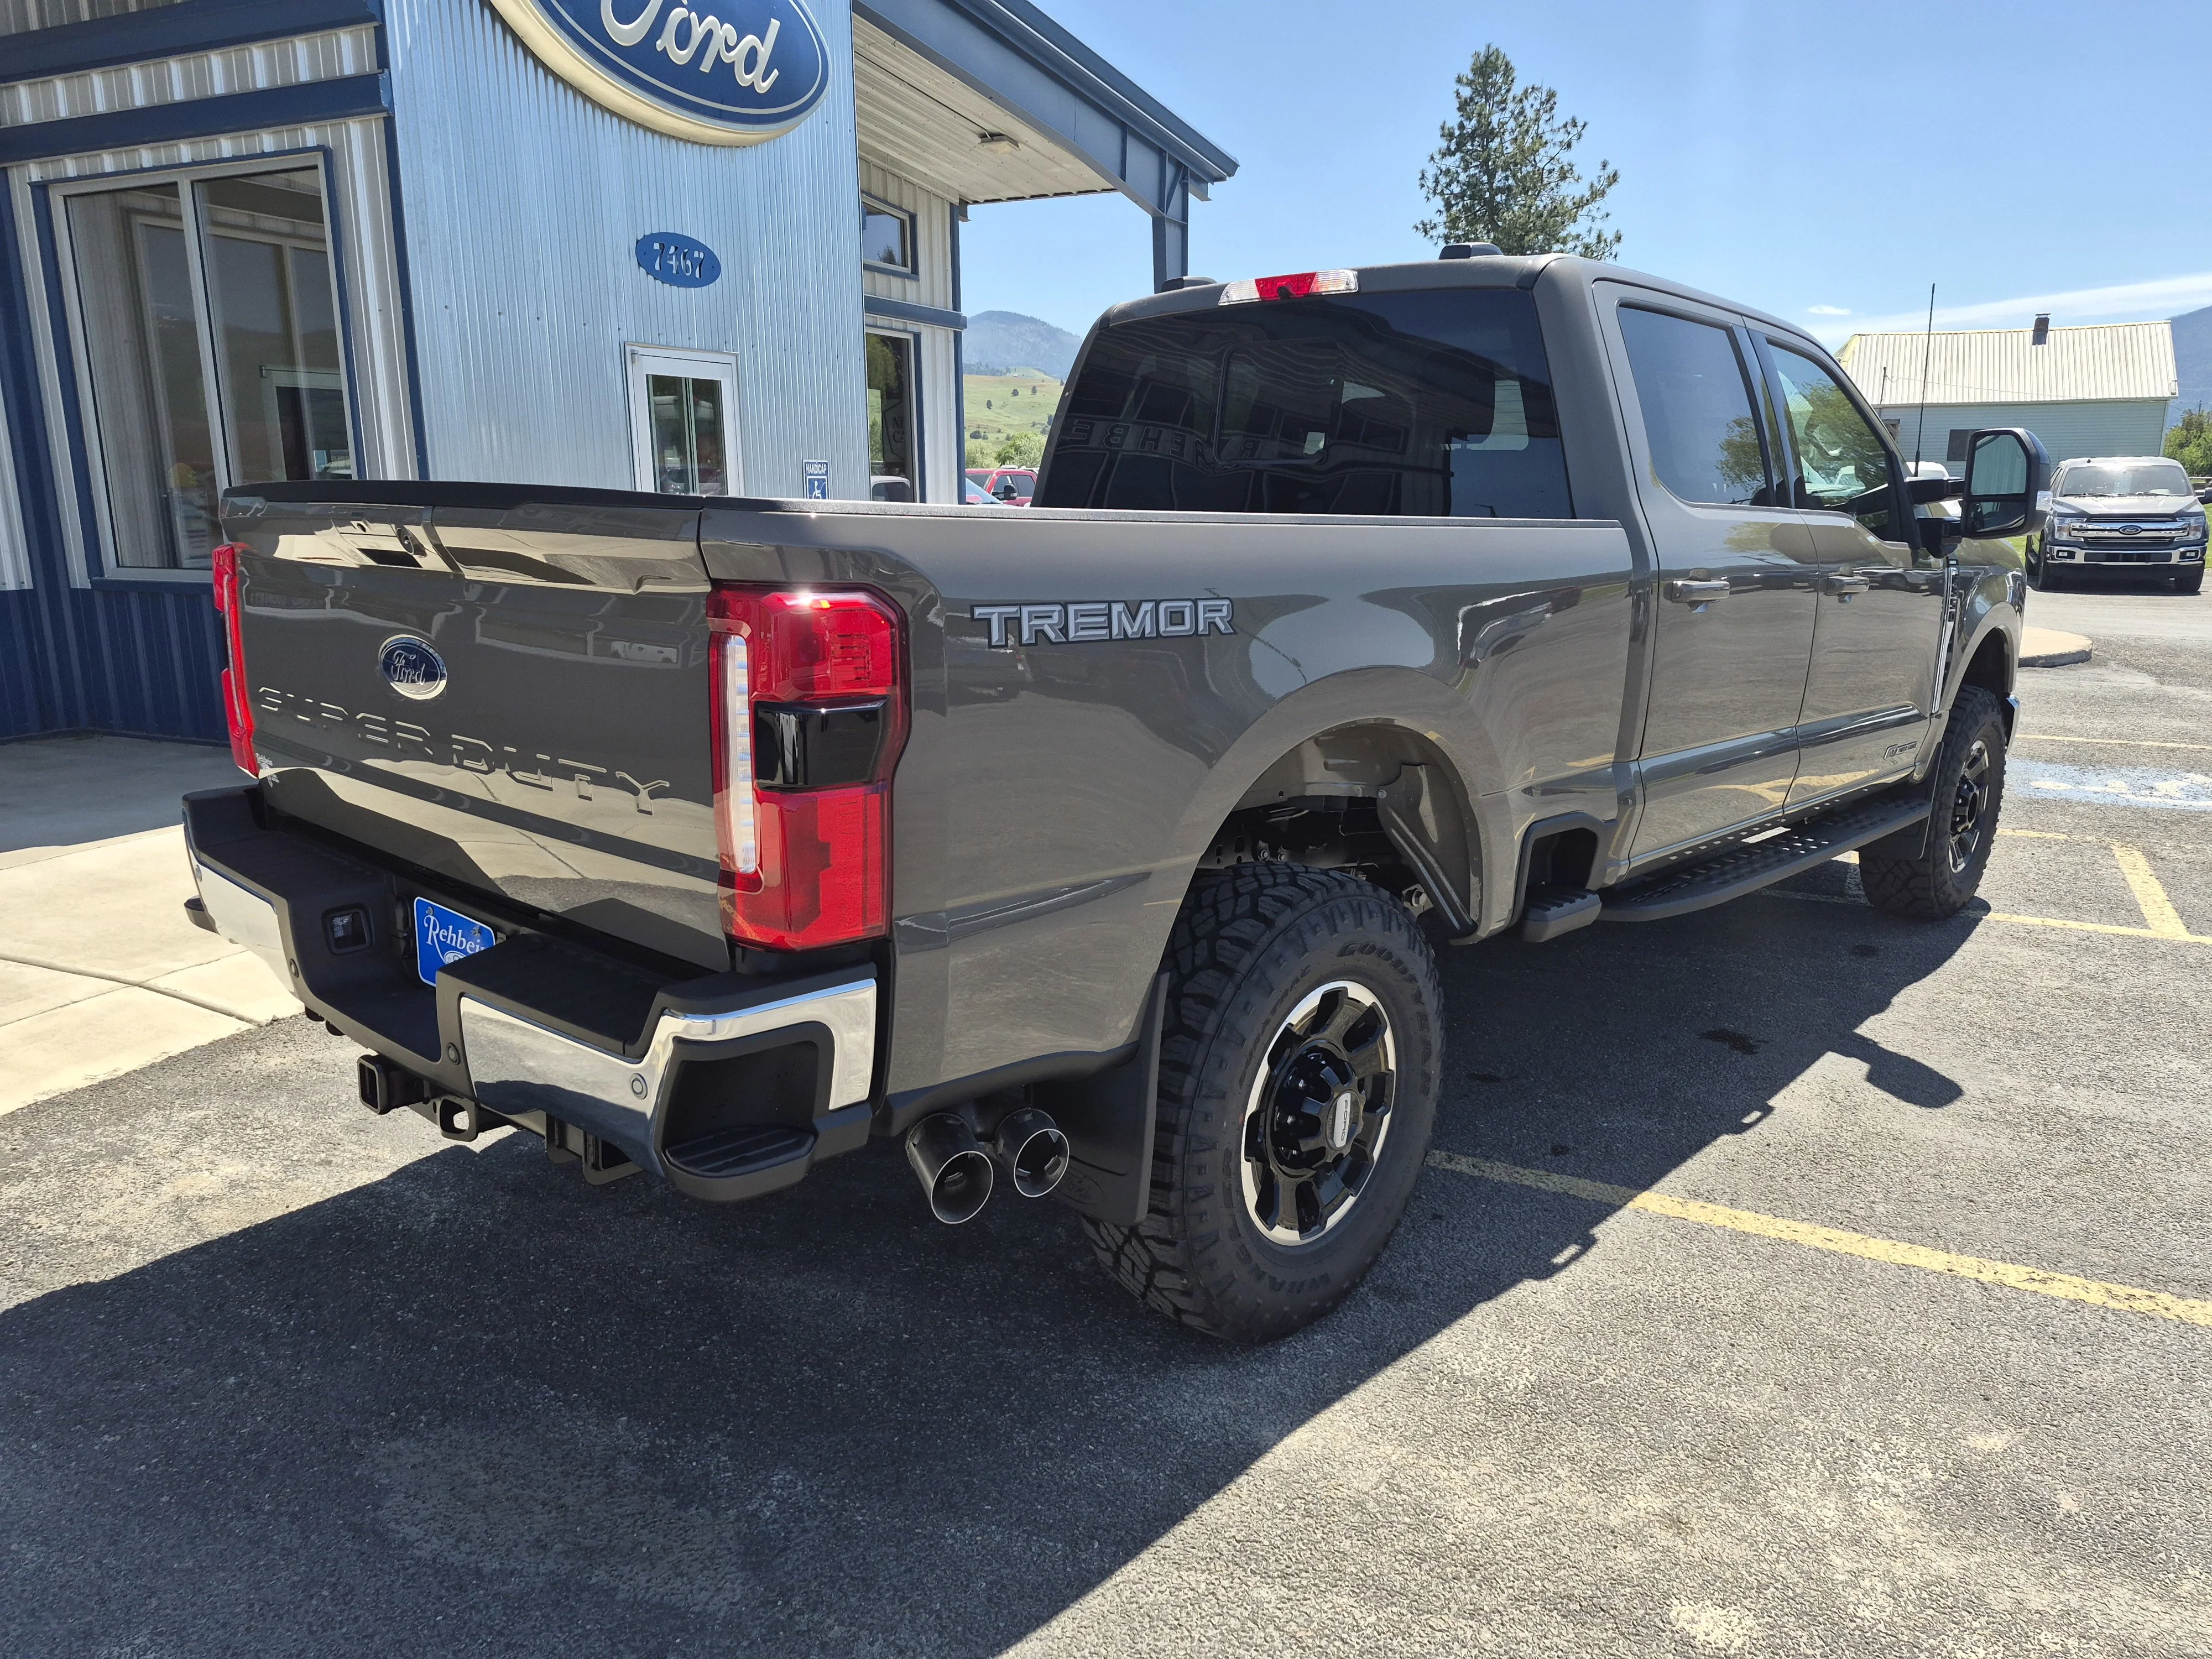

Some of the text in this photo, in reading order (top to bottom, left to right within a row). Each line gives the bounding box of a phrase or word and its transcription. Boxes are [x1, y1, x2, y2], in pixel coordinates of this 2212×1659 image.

[653, 242, 705, 279] 7467
[806, 463, 827, 474] HANDICAP
[971, 597, 1238, 648] TREMOR
[391, 650, 425, 686] Ford
[259, 686, 670, 816] SUPER DUTY
